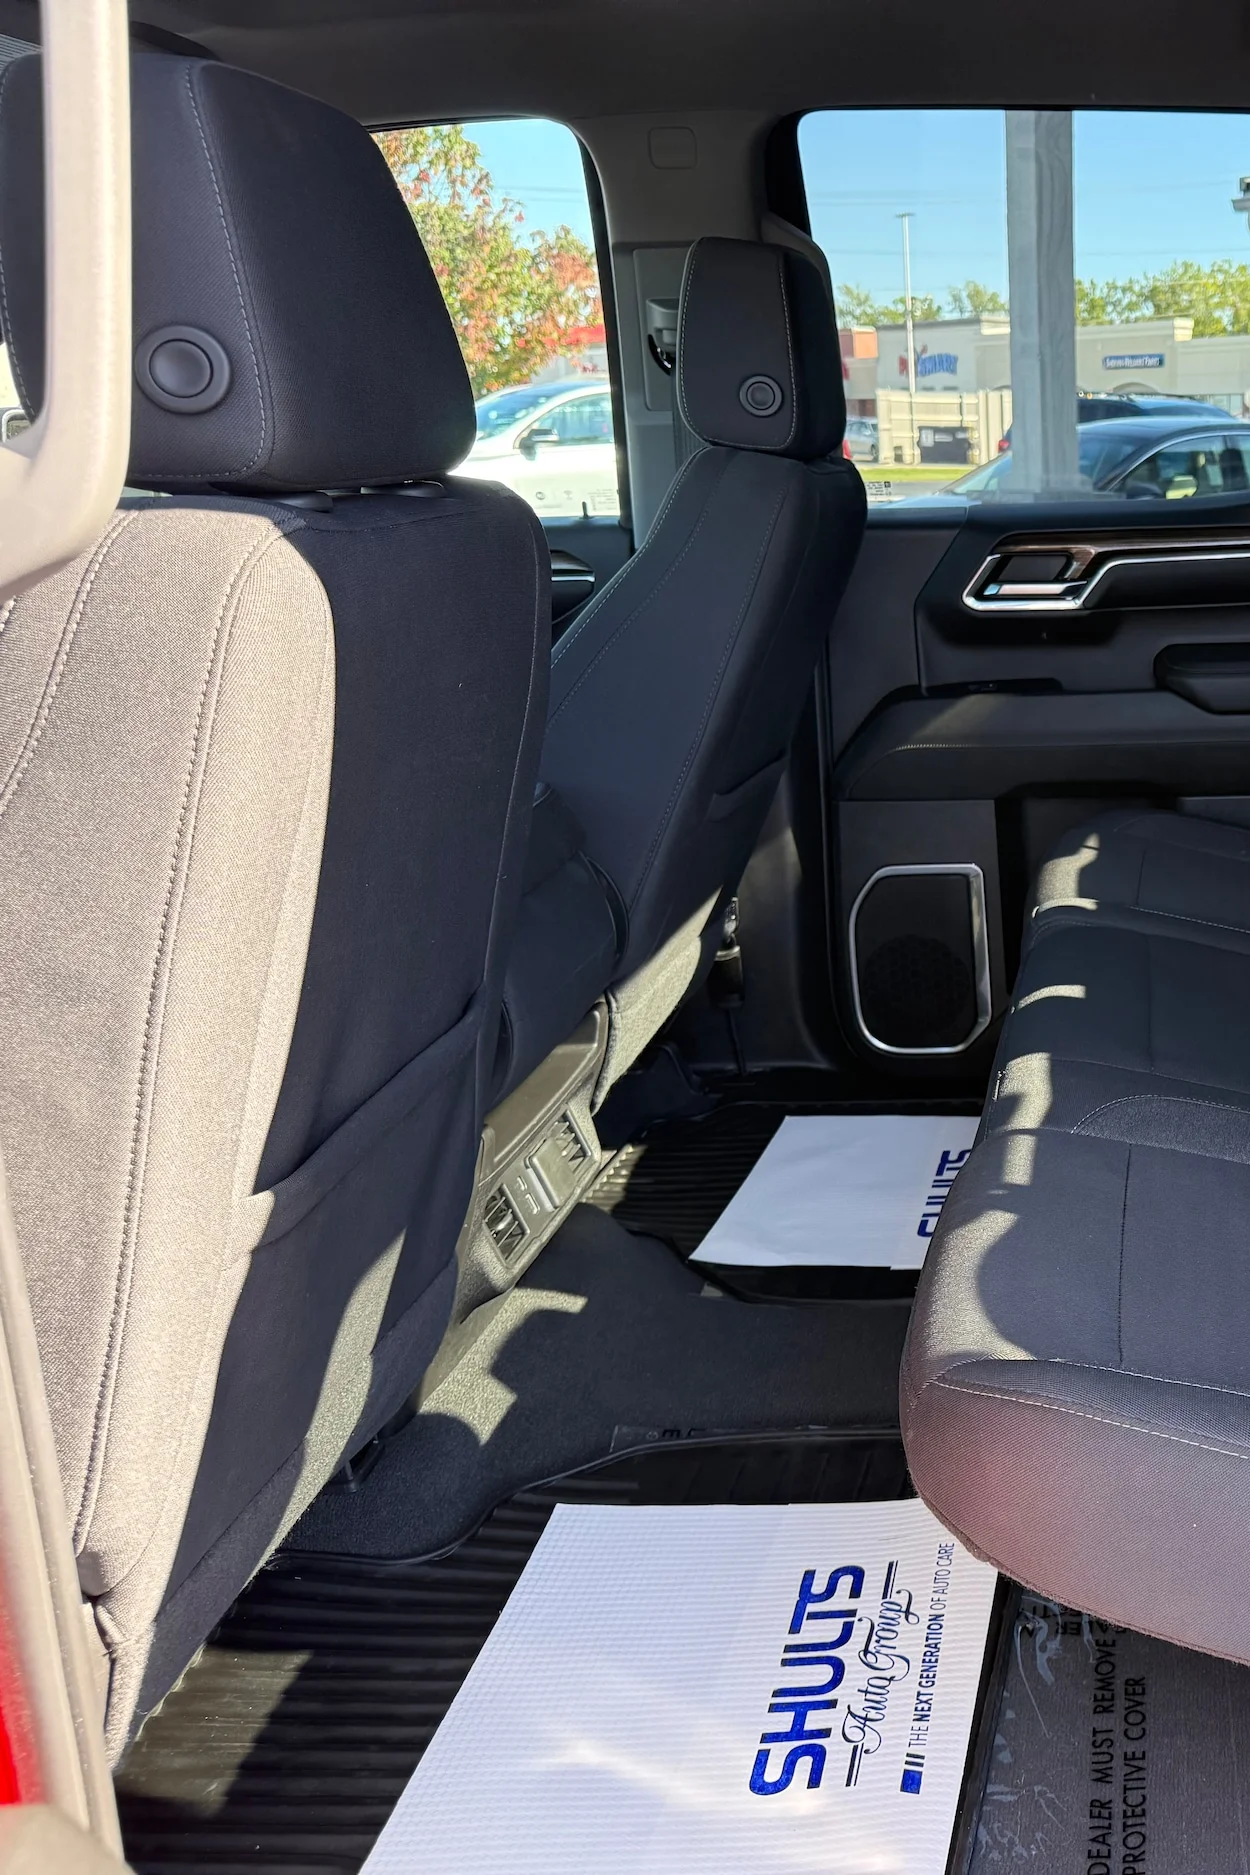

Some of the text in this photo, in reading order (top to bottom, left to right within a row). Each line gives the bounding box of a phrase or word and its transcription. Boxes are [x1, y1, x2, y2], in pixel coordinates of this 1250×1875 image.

[749, 1565, 866, 1796] SHULTS
[841, 1588, 920, 1754] Auto Group
[908, 1542, 955, 1748] THE NEXT GENERATION OF AUTO CARE
[1087, 1638, 1117, 1875] DEALER MUST REMOVE
[1121, 1676, 1147, 1875] PROTECTIVE COVER
